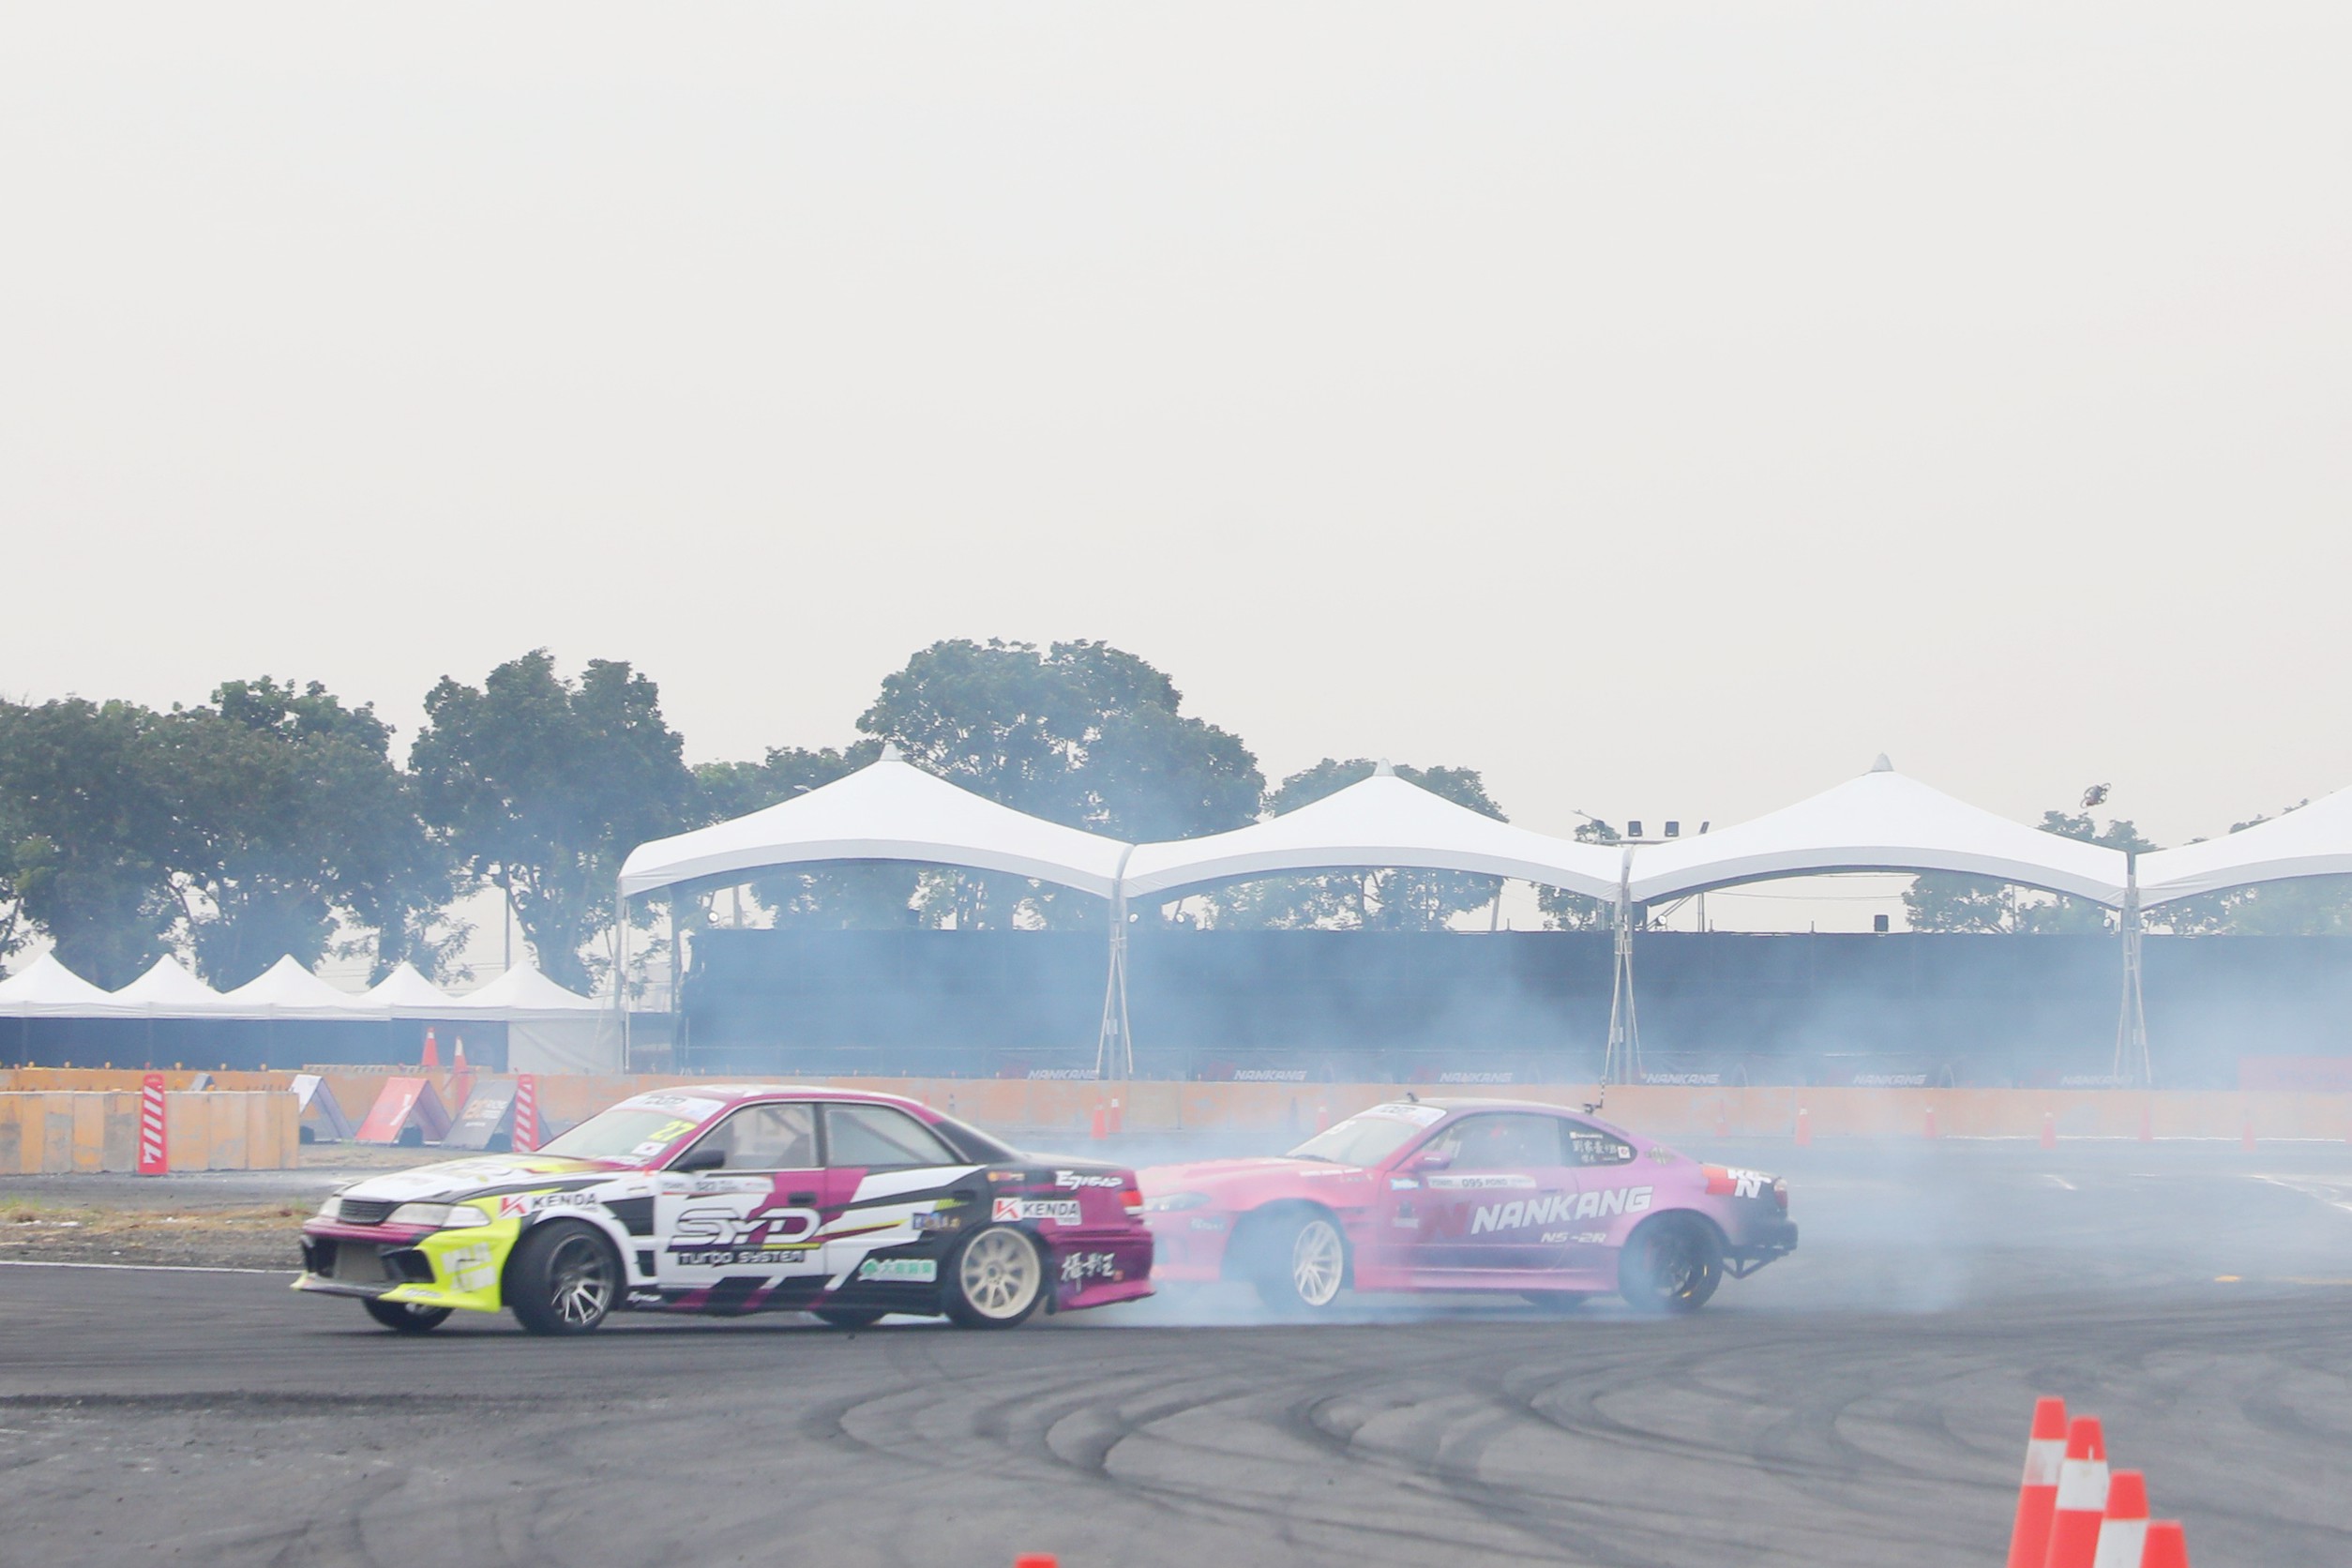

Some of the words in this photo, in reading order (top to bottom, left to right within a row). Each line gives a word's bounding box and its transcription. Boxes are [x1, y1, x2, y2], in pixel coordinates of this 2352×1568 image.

[1234, 1070, 1307, 1081] NANKANG
[1440, 1072, 1514, 1083] NANKANG
[1646, 1074, 1720, 1084] NANKANG
[1853, 1074, 1927, 1085] NANKANG
[647, 1120, 699, 1142] 27
[532, 1193, 597, 1209] KENDA
[1022, 1202, 1079, 1216] KENDA
[1471, 1185, 1652, 1235] NANKANG
